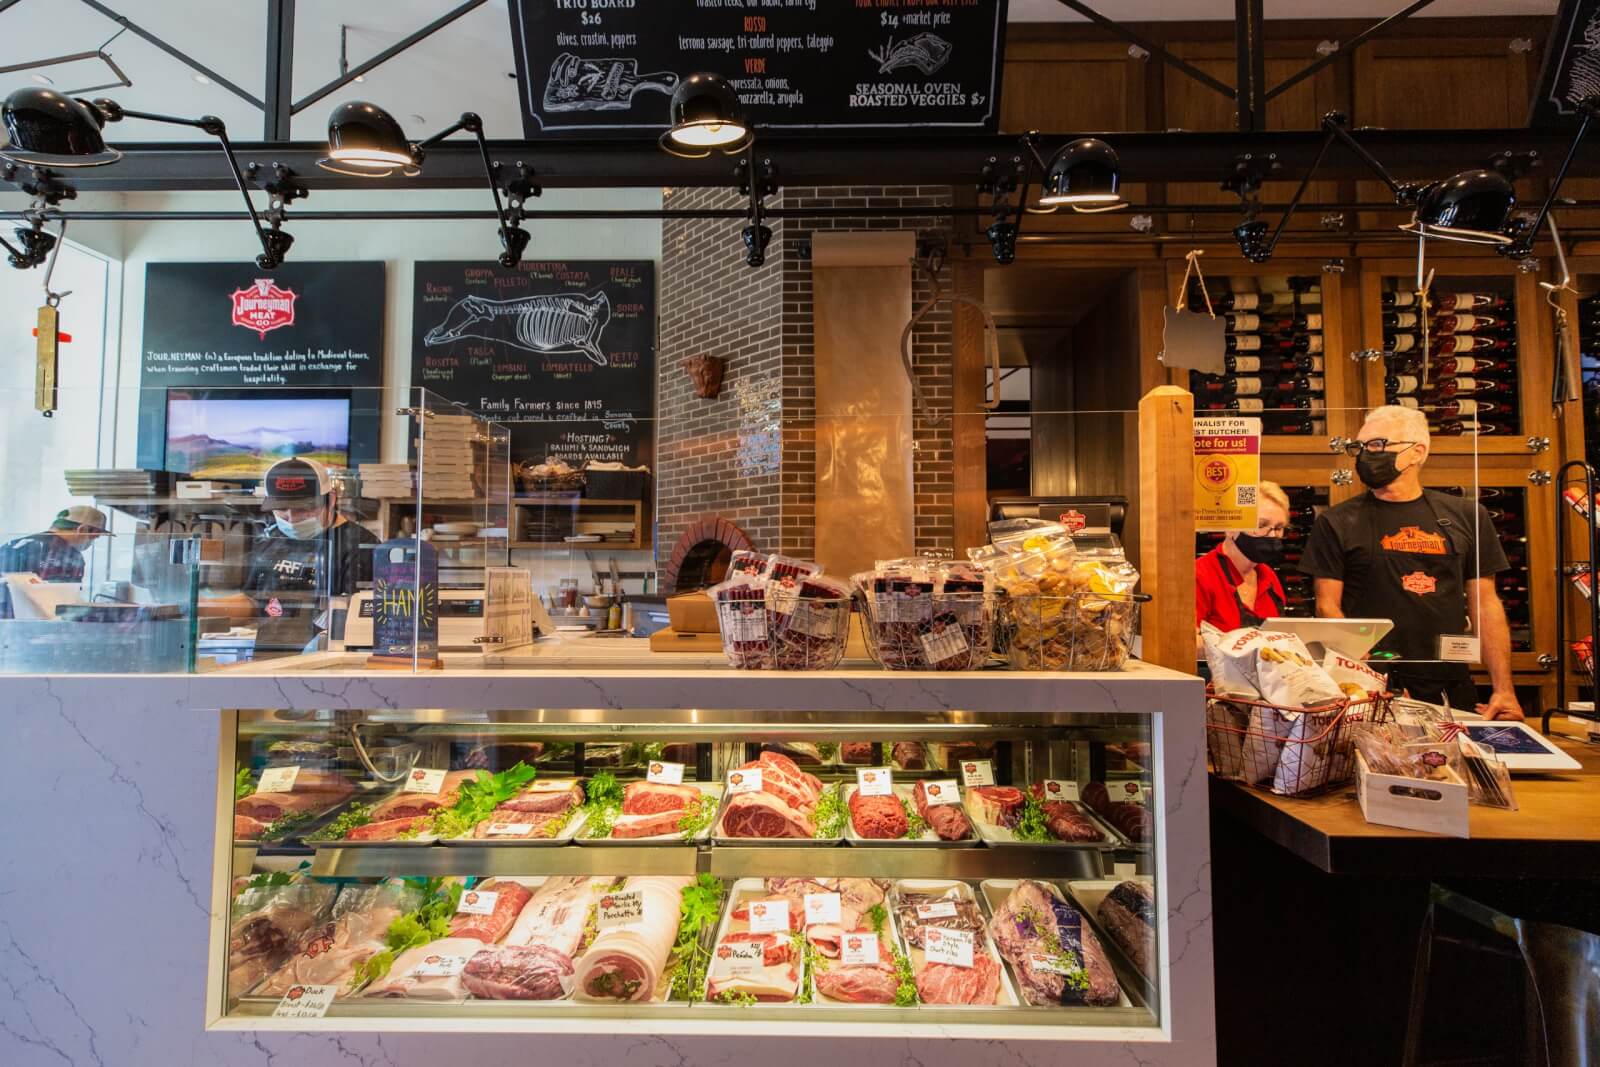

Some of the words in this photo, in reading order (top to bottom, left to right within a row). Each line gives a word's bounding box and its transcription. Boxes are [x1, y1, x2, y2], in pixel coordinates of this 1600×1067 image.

[580, 10, 602, 26] $26
[744, 15, 766, 33] ROSSO
[880, 10, 899, 29] $14
[933, 12, 952, 30] price
[611, 33, 638, 49] peppers
[806, 33, 834, 53] taleggio
[744, 57, 766, 74] VERDE
[765, 77, 790, 90] onions,
[855, 83, 921, 96] SEASONAL
[923, 82, 961, 95] OVEN
[848, 94, 907, 107] ROASTED
[910, 94, 966, 106] VEGGIES
[970, 91, 986, 107] $7
[249, 311, 276, 321] MEAT
[481, 398, 509, 412] Family
[514, 398, 551, 411] Farmers
[589, 444, 631, 454] SANDWICH
[1194, 439, 1213, 448] ote
[1213, 437, 1230, 448] for
[1231, 438, 1248, 448] us!
[585, 453, 625, 462] AVAILABLE
[1206, 466, 1228, 478] BEST
[383, 588, 425, 618] HAM
